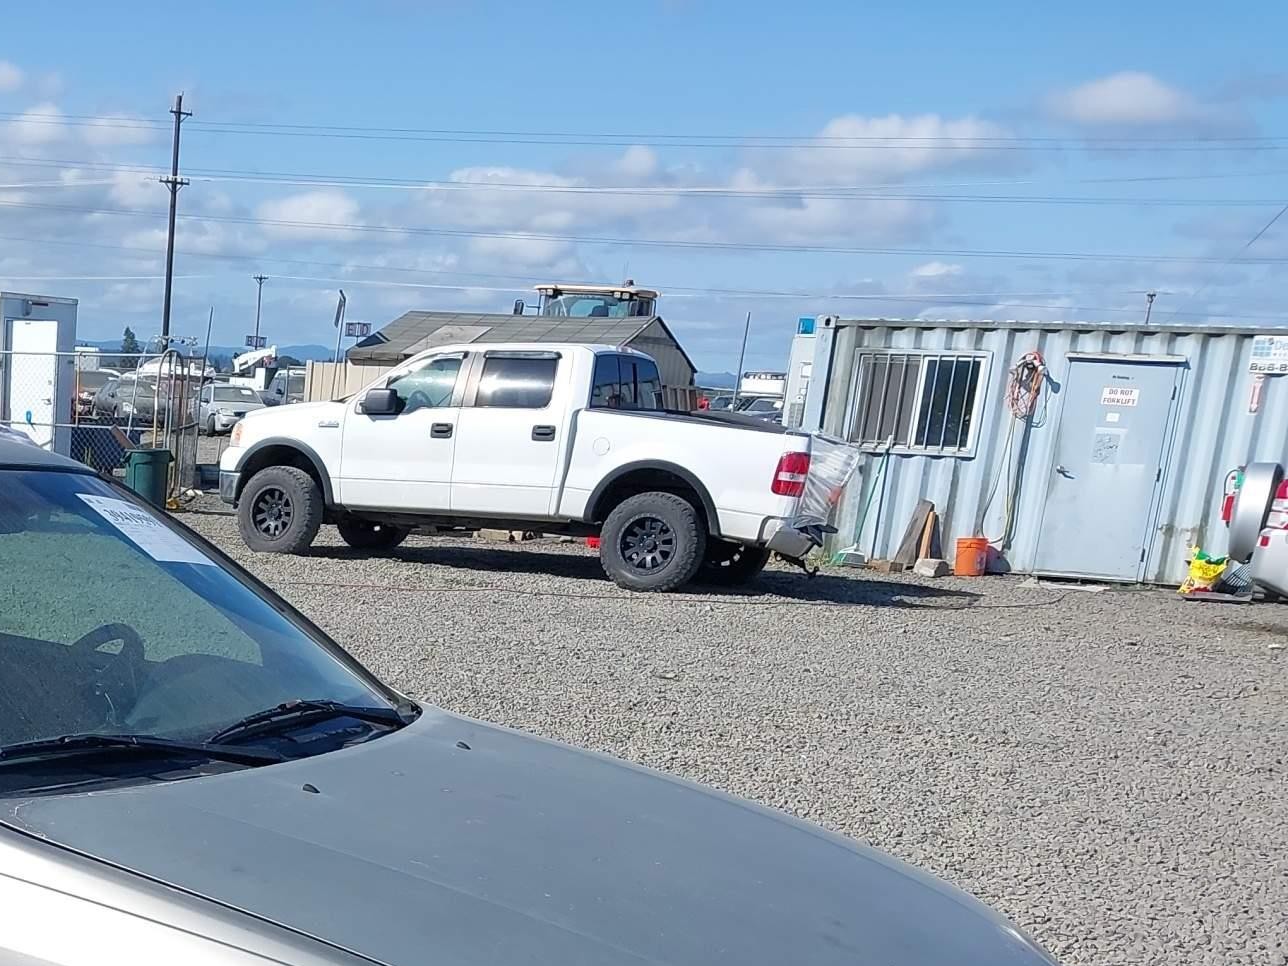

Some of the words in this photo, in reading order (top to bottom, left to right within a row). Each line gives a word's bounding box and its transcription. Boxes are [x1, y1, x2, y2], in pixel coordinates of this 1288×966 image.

[1108, 388, 1118, 396] DO
[1119, 389, 1134, 397] NOT
[1102, 396, 1136, 405] FORKLIFT
